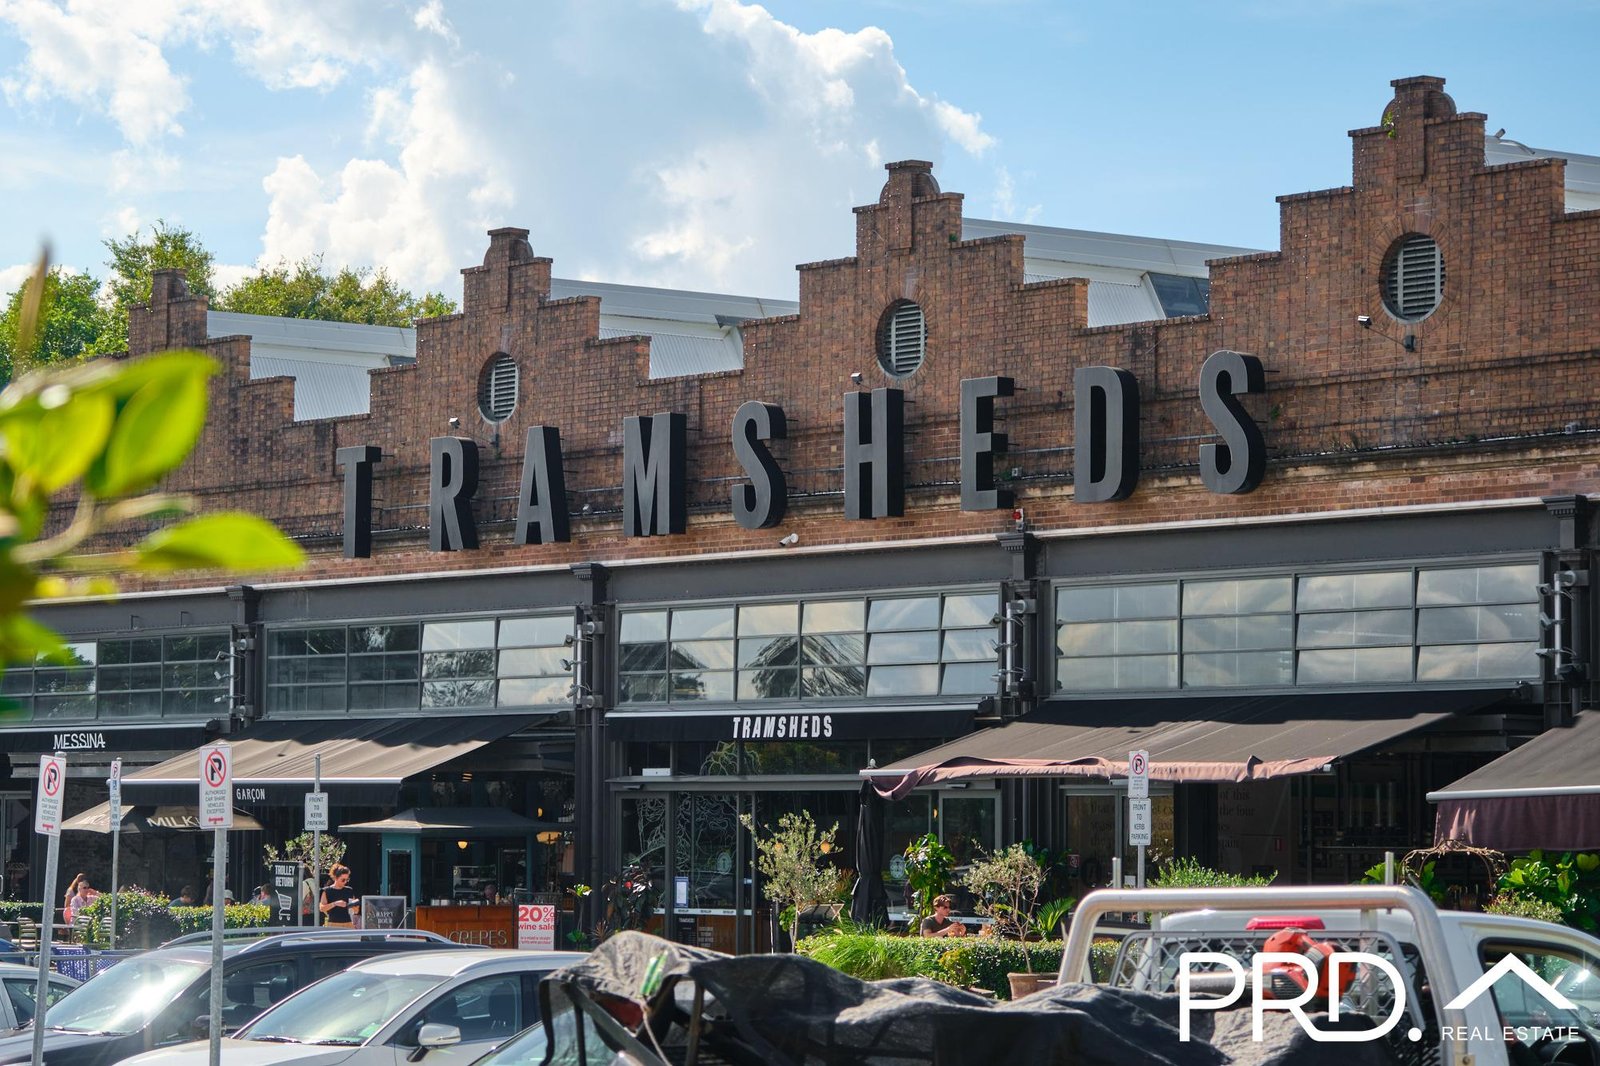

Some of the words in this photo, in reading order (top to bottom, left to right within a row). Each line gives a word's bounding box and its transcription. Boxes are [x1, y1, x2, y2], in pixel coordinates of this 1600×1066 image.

[336, 350, 1267, 558] TRAMSHEDS
[733, 715, 832, 739] TRAMSHEDS
[53, 732, 106, 750] MESSINA
[236, 788, 266, 803] GARÇON
[1132, 803, 1147, 811] FRONT
[1136, 813, 1143, 821] TO
[1133, 823, 1146, 831] KERB
[274, 864, 296, 876] TROLLEY
[274, 876, 295, 888] RETURN
[519, 906, 555, 922] 20%
